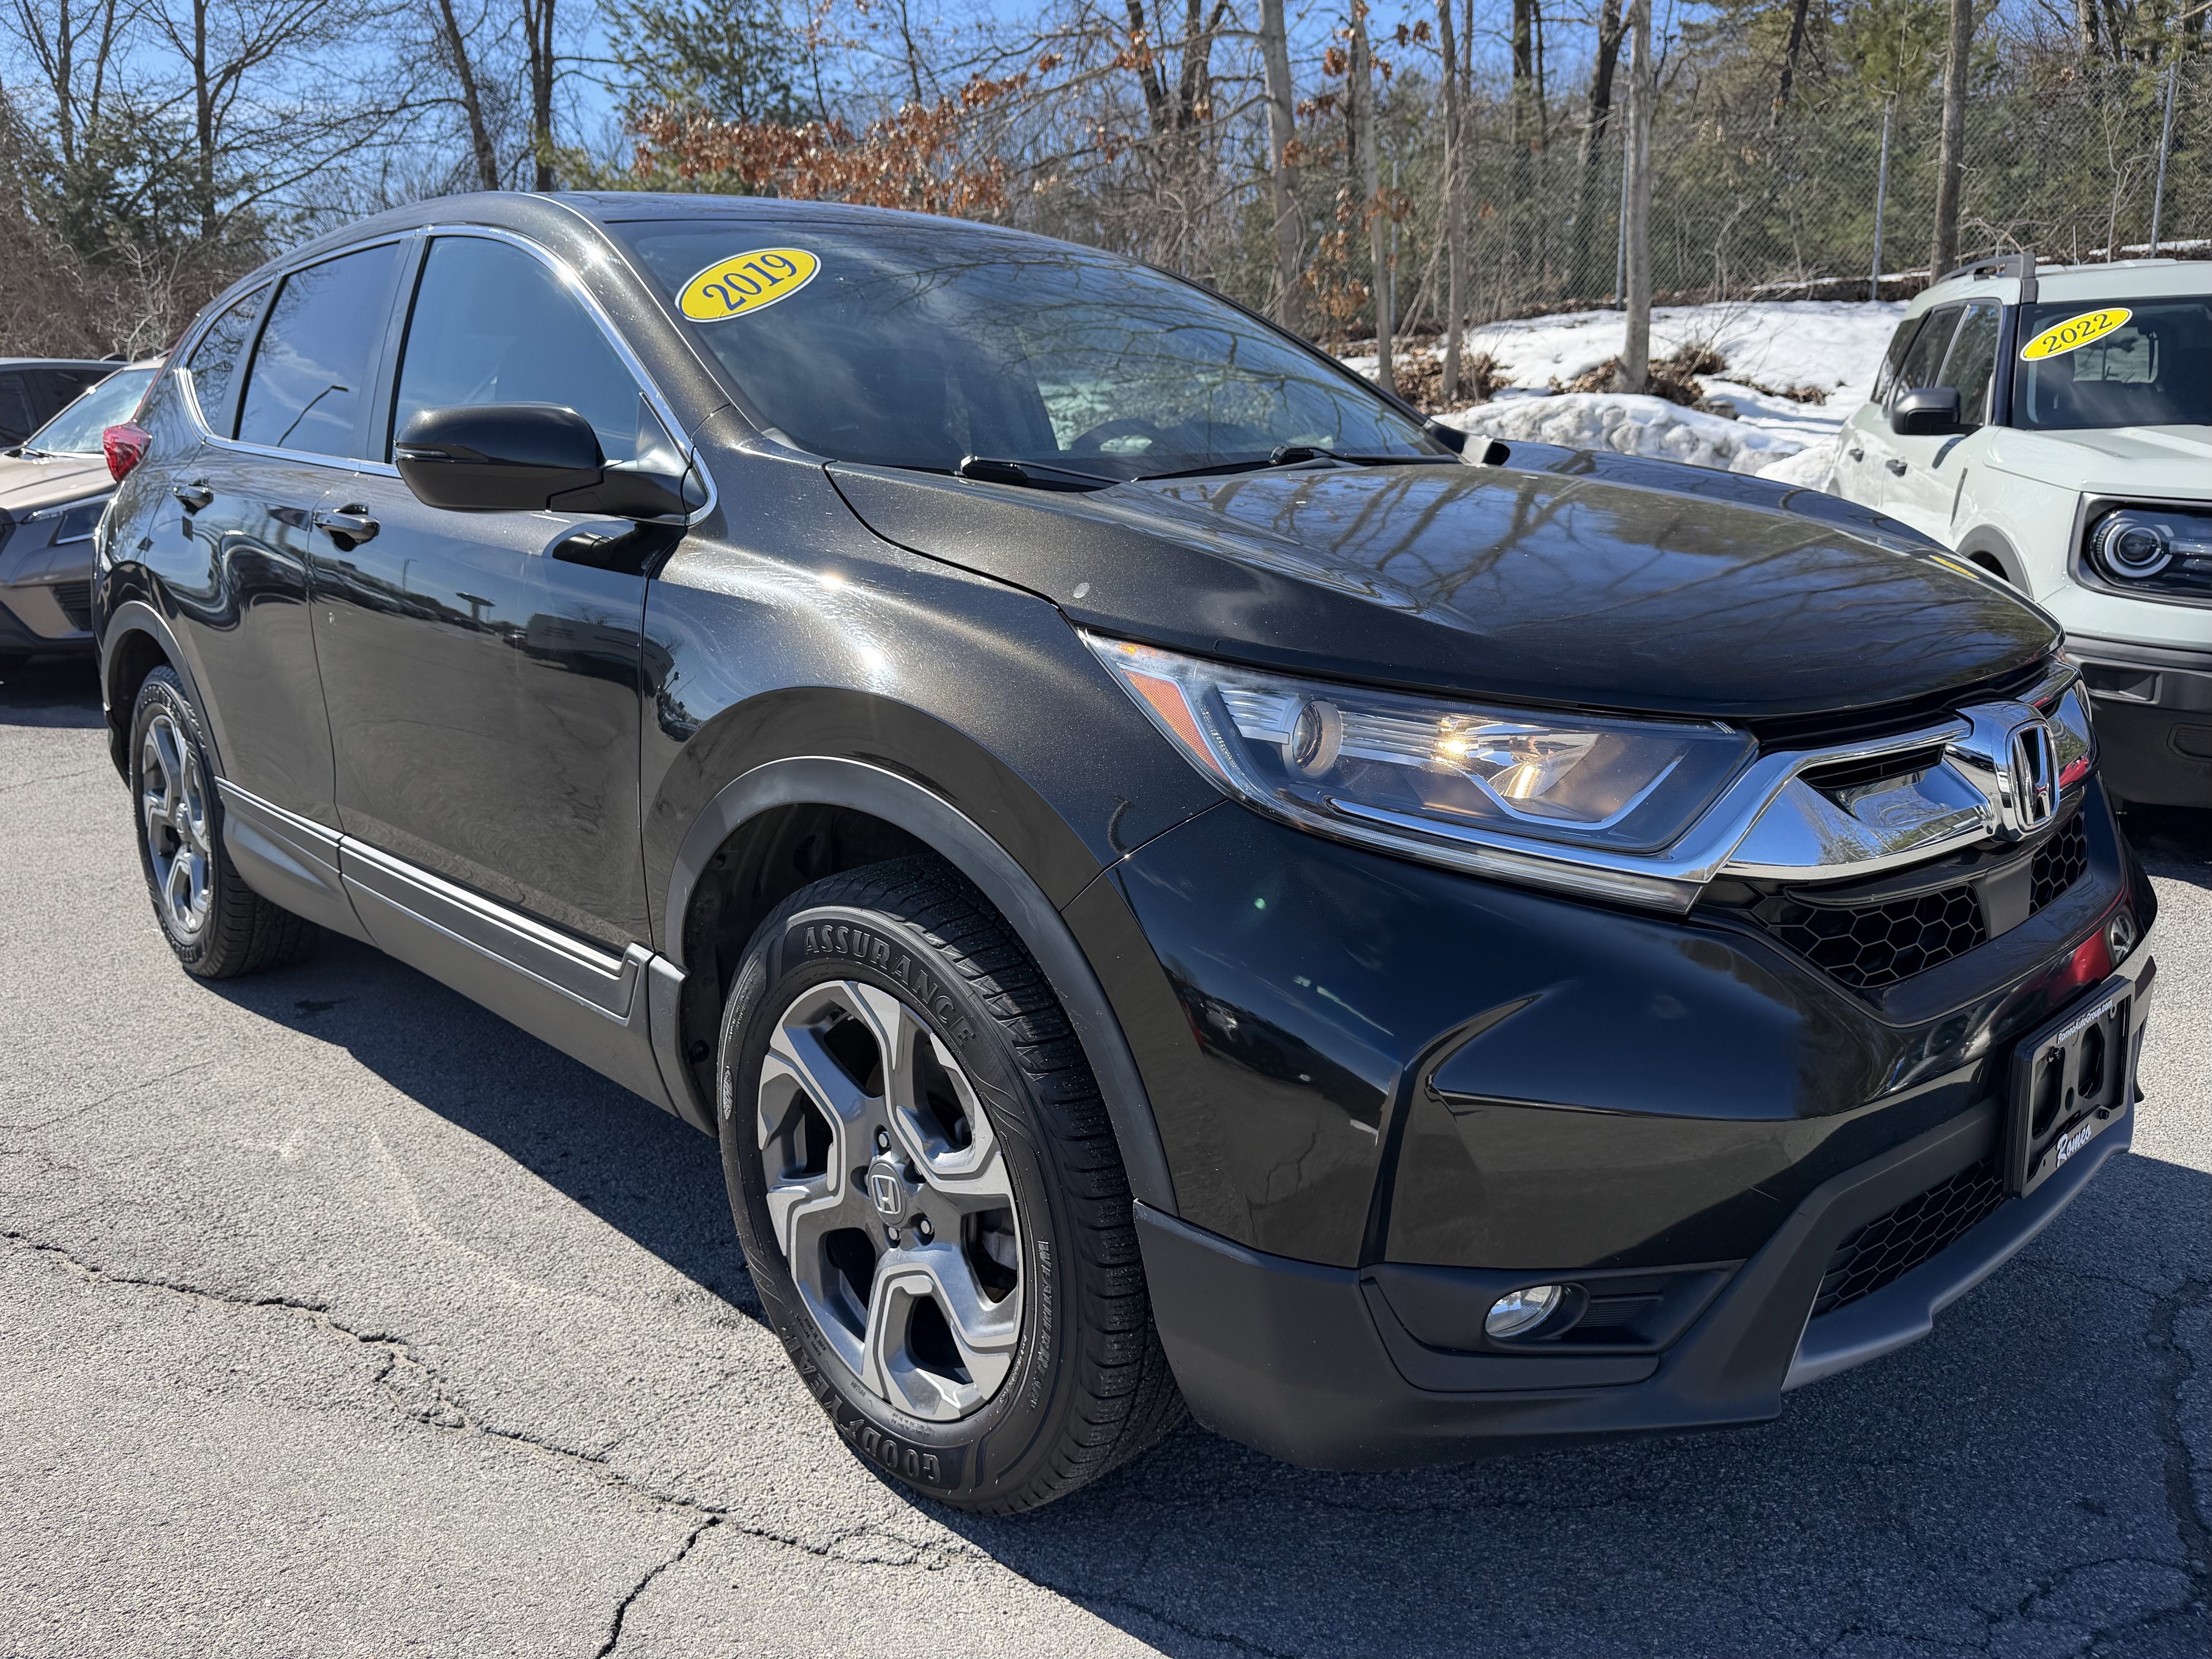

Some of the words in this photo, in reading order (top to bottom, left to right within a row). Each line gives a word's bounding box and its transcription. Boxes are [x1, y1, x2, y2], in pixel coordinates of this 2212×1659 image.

[703, 254, 797, 311] 2019
[2043, 314, 2113, 353] 2022
[804, 925, 977, 1046] ASSURANCE
[2057, 999, 2112, 1044] RomeoAutoGroup.com
[2056, 1123, 2091, 1168] Romeo
[782, 1327, 941, 1483] GOODYEAR
